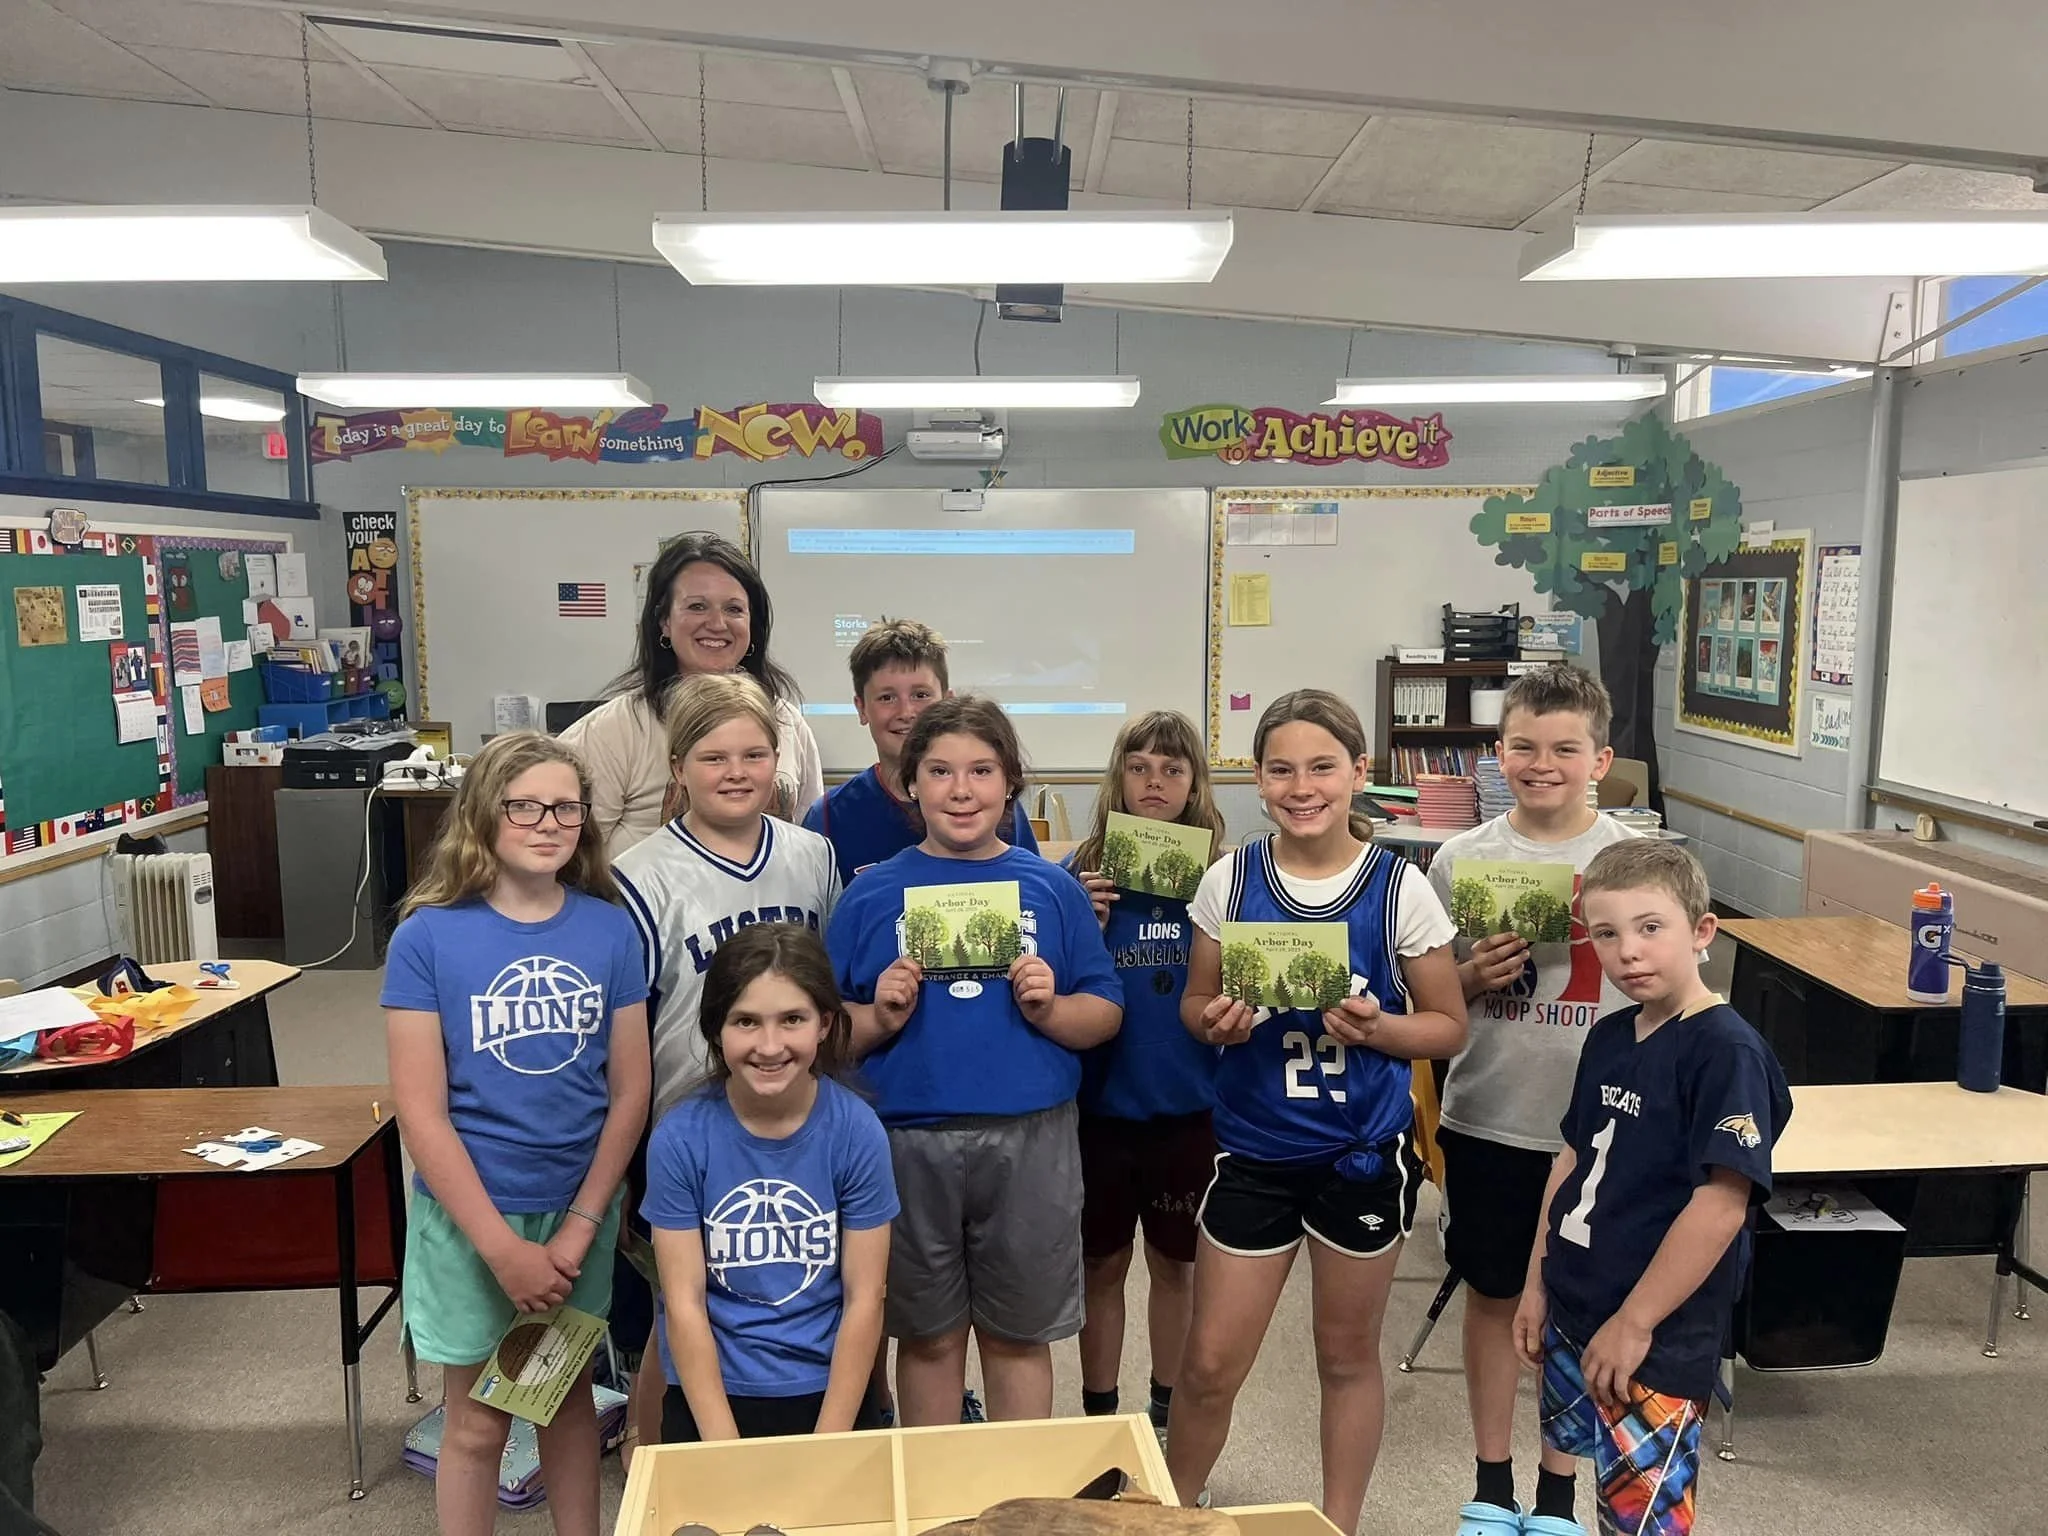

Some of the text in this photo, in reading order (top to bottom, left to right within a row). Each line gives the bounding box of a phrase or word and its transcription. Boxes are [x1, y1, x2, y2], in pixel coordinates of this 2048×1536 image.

[316, 415, 506, 454] Today is a great day to
[599, 432, 684, 454] something
[1172, 409, 1438, 461] Work to Achieve it
[352, 514, 394, 530] check
[1590, 508, 1619, 518] Parts
[1623, 508, 1635, 517] of
[347, 529, 380, 548] your
[834, 619, 868, 629] Storks
[1132, 829, 1162, 842] Arbor
[1164, 834, 1182, 847] Day
[1484, 874, 1543, 887] Arbor Day
[934, 898, 990, 909] Arbor Day
[1139, 923, 1181, 940] LIONS
[1253, 937, 1315, 949] Arbor Day
[478, 991, 601, 1045] LIONS
[1484, 999, 1599, 1027] HOOP SHOOT
[1283, 1031, 1346, 1103] 22
[1559, 1118, 1616, 1248] 1
[705, 1220, 830, 1264] LIONS
